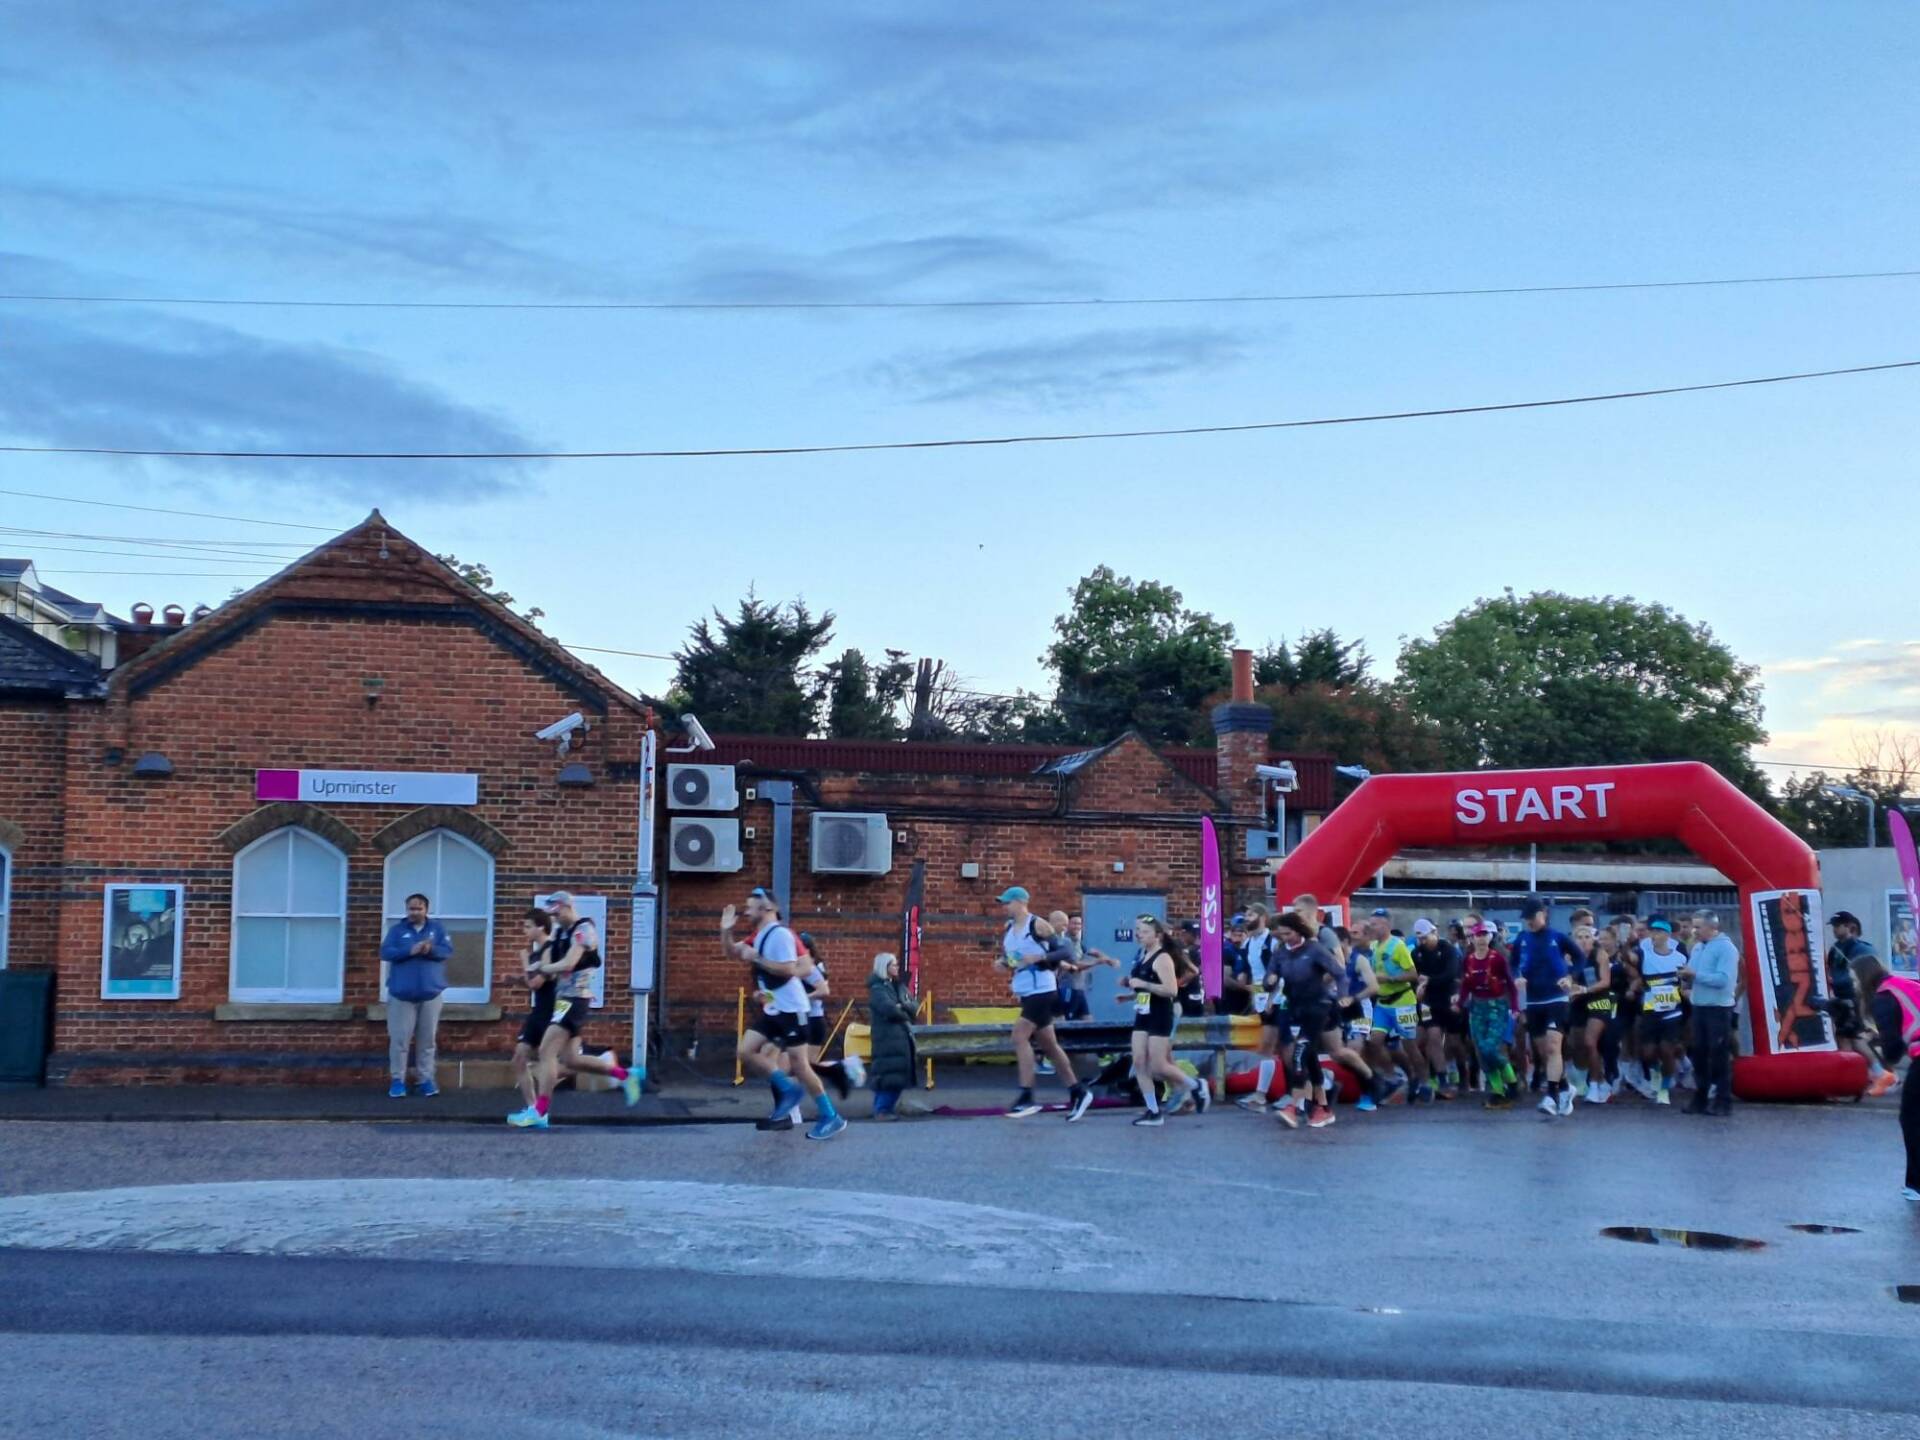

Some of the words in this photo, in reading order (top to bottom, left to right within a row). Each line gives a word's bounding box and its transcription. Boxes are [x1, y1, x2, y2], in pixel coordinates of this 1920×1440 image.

[312, 778, 396, 797] Upminster
[1455, 782, 1616, 825] START
[1204, 884, 1217, 934] CSC
